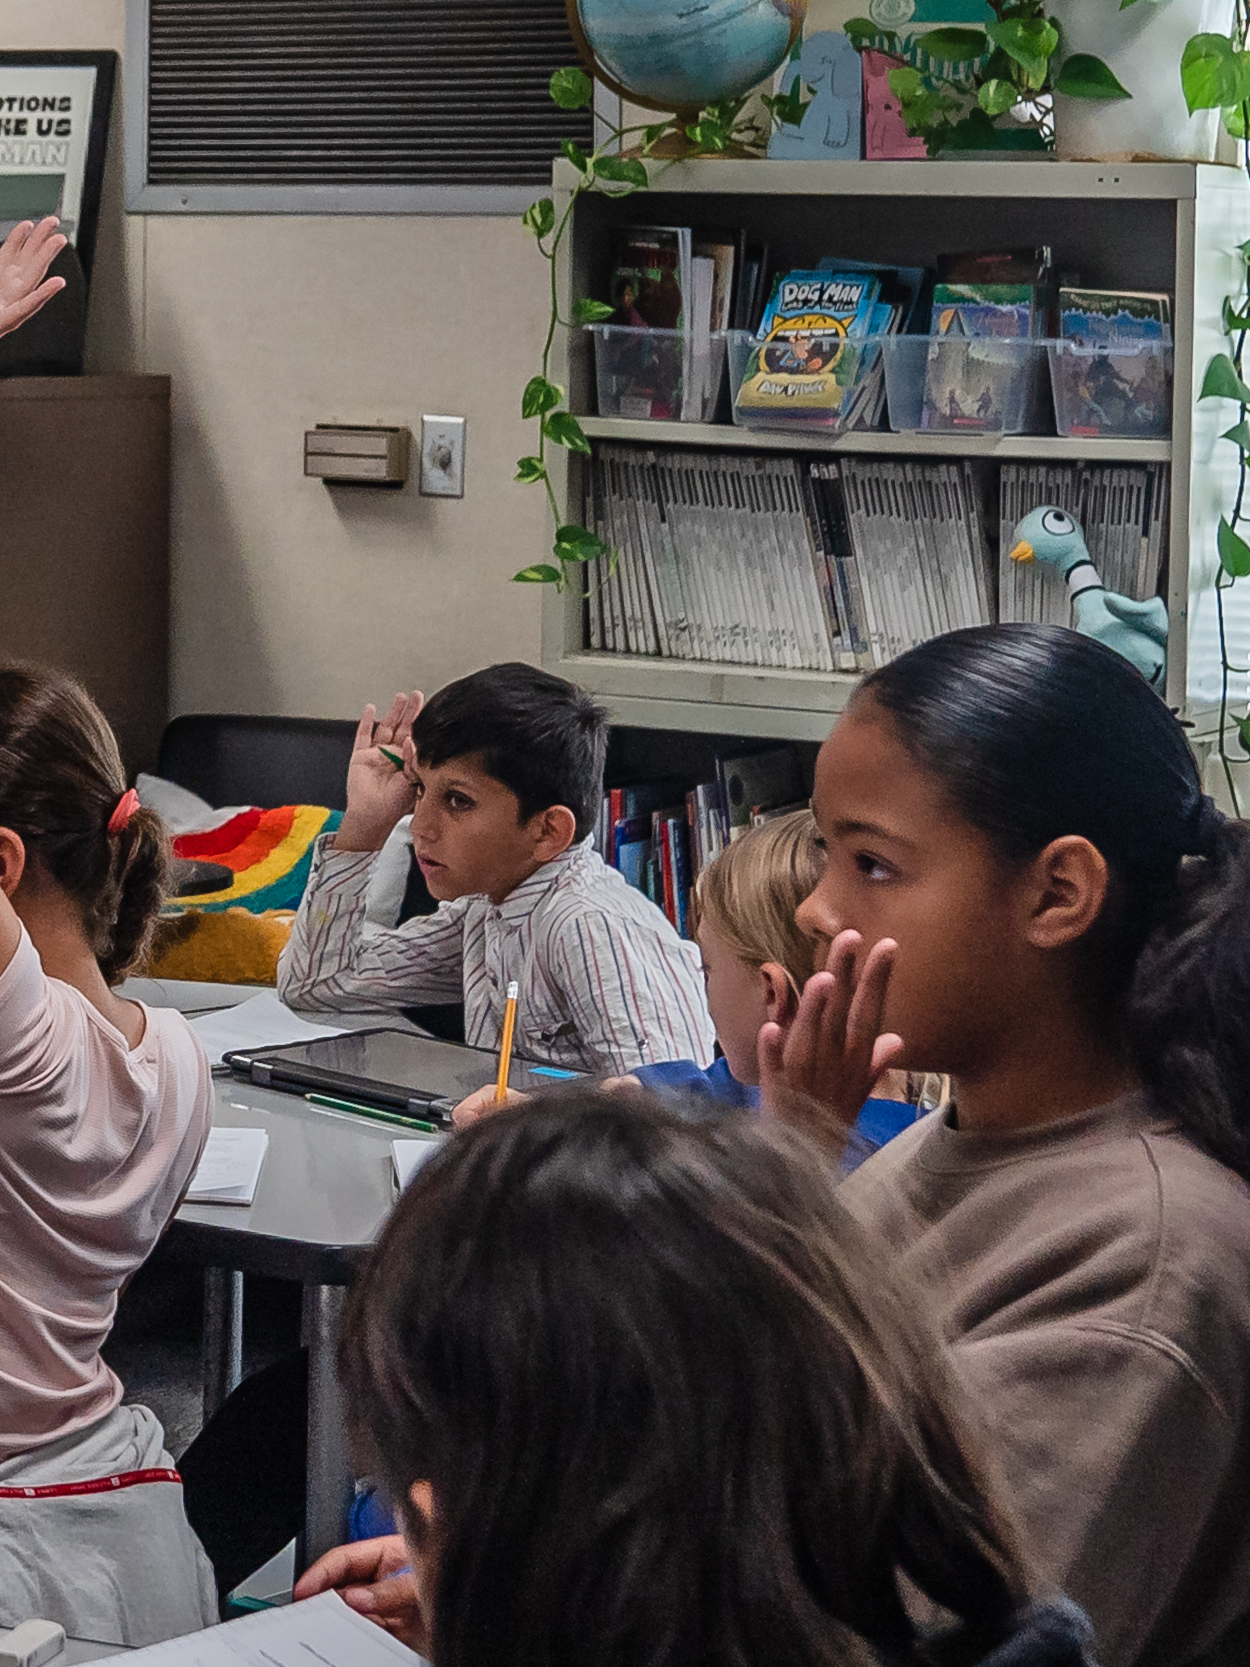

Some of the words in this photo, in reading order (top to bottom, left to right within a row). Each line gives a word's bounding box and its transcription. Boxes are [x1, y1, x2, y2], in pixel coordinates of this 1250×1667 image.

[36, 118, 72, 137] US
[783, 281, 821, 303] DOG
[822, 281, 862, 303] MAN
